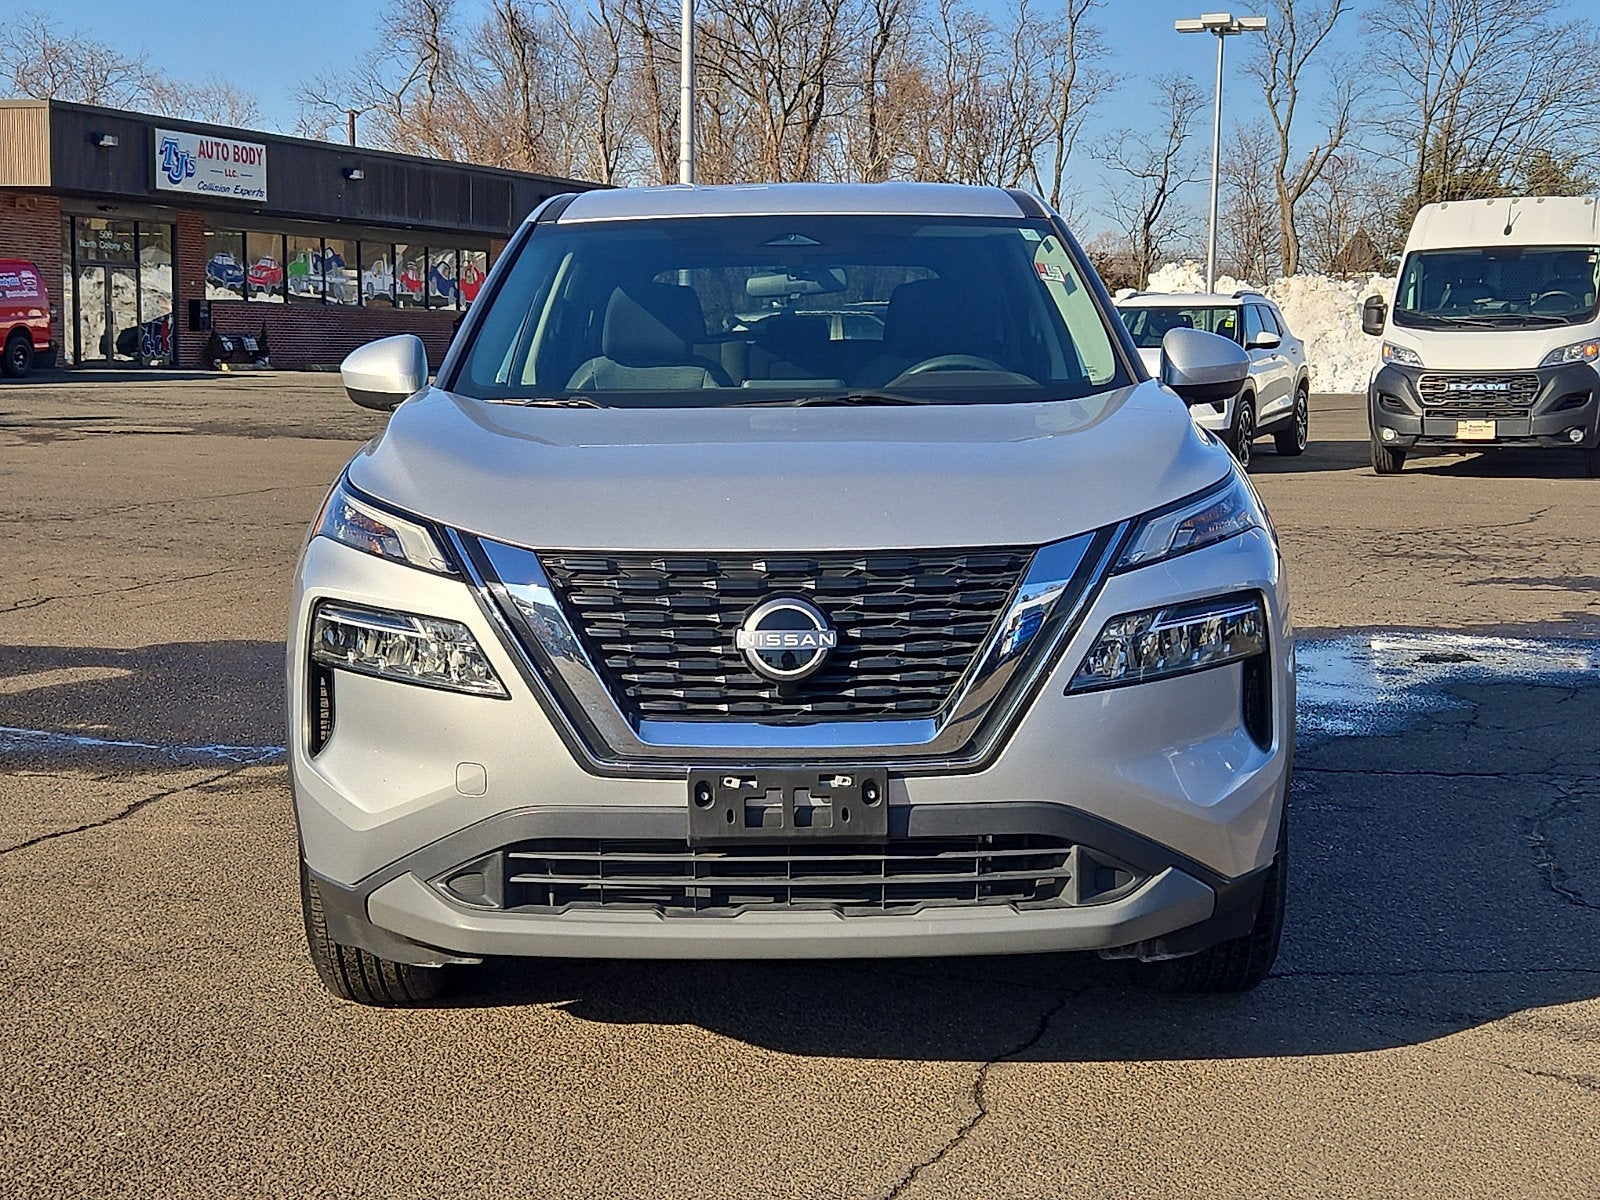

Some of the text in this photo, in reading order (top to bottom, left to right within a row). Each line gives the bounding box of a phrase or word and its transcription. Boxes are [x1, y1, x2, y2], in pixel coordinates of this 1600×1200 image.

[198, 140, 263, 166] AUTO BODY
[197, 180, 265, 198] Collision Experts
[79, 240, 97, 249] North
[99, 241, 121, 251] Colony
[1449, 383, 1508, 391] RAM
[740, 633, 834, 646] NISSAN
